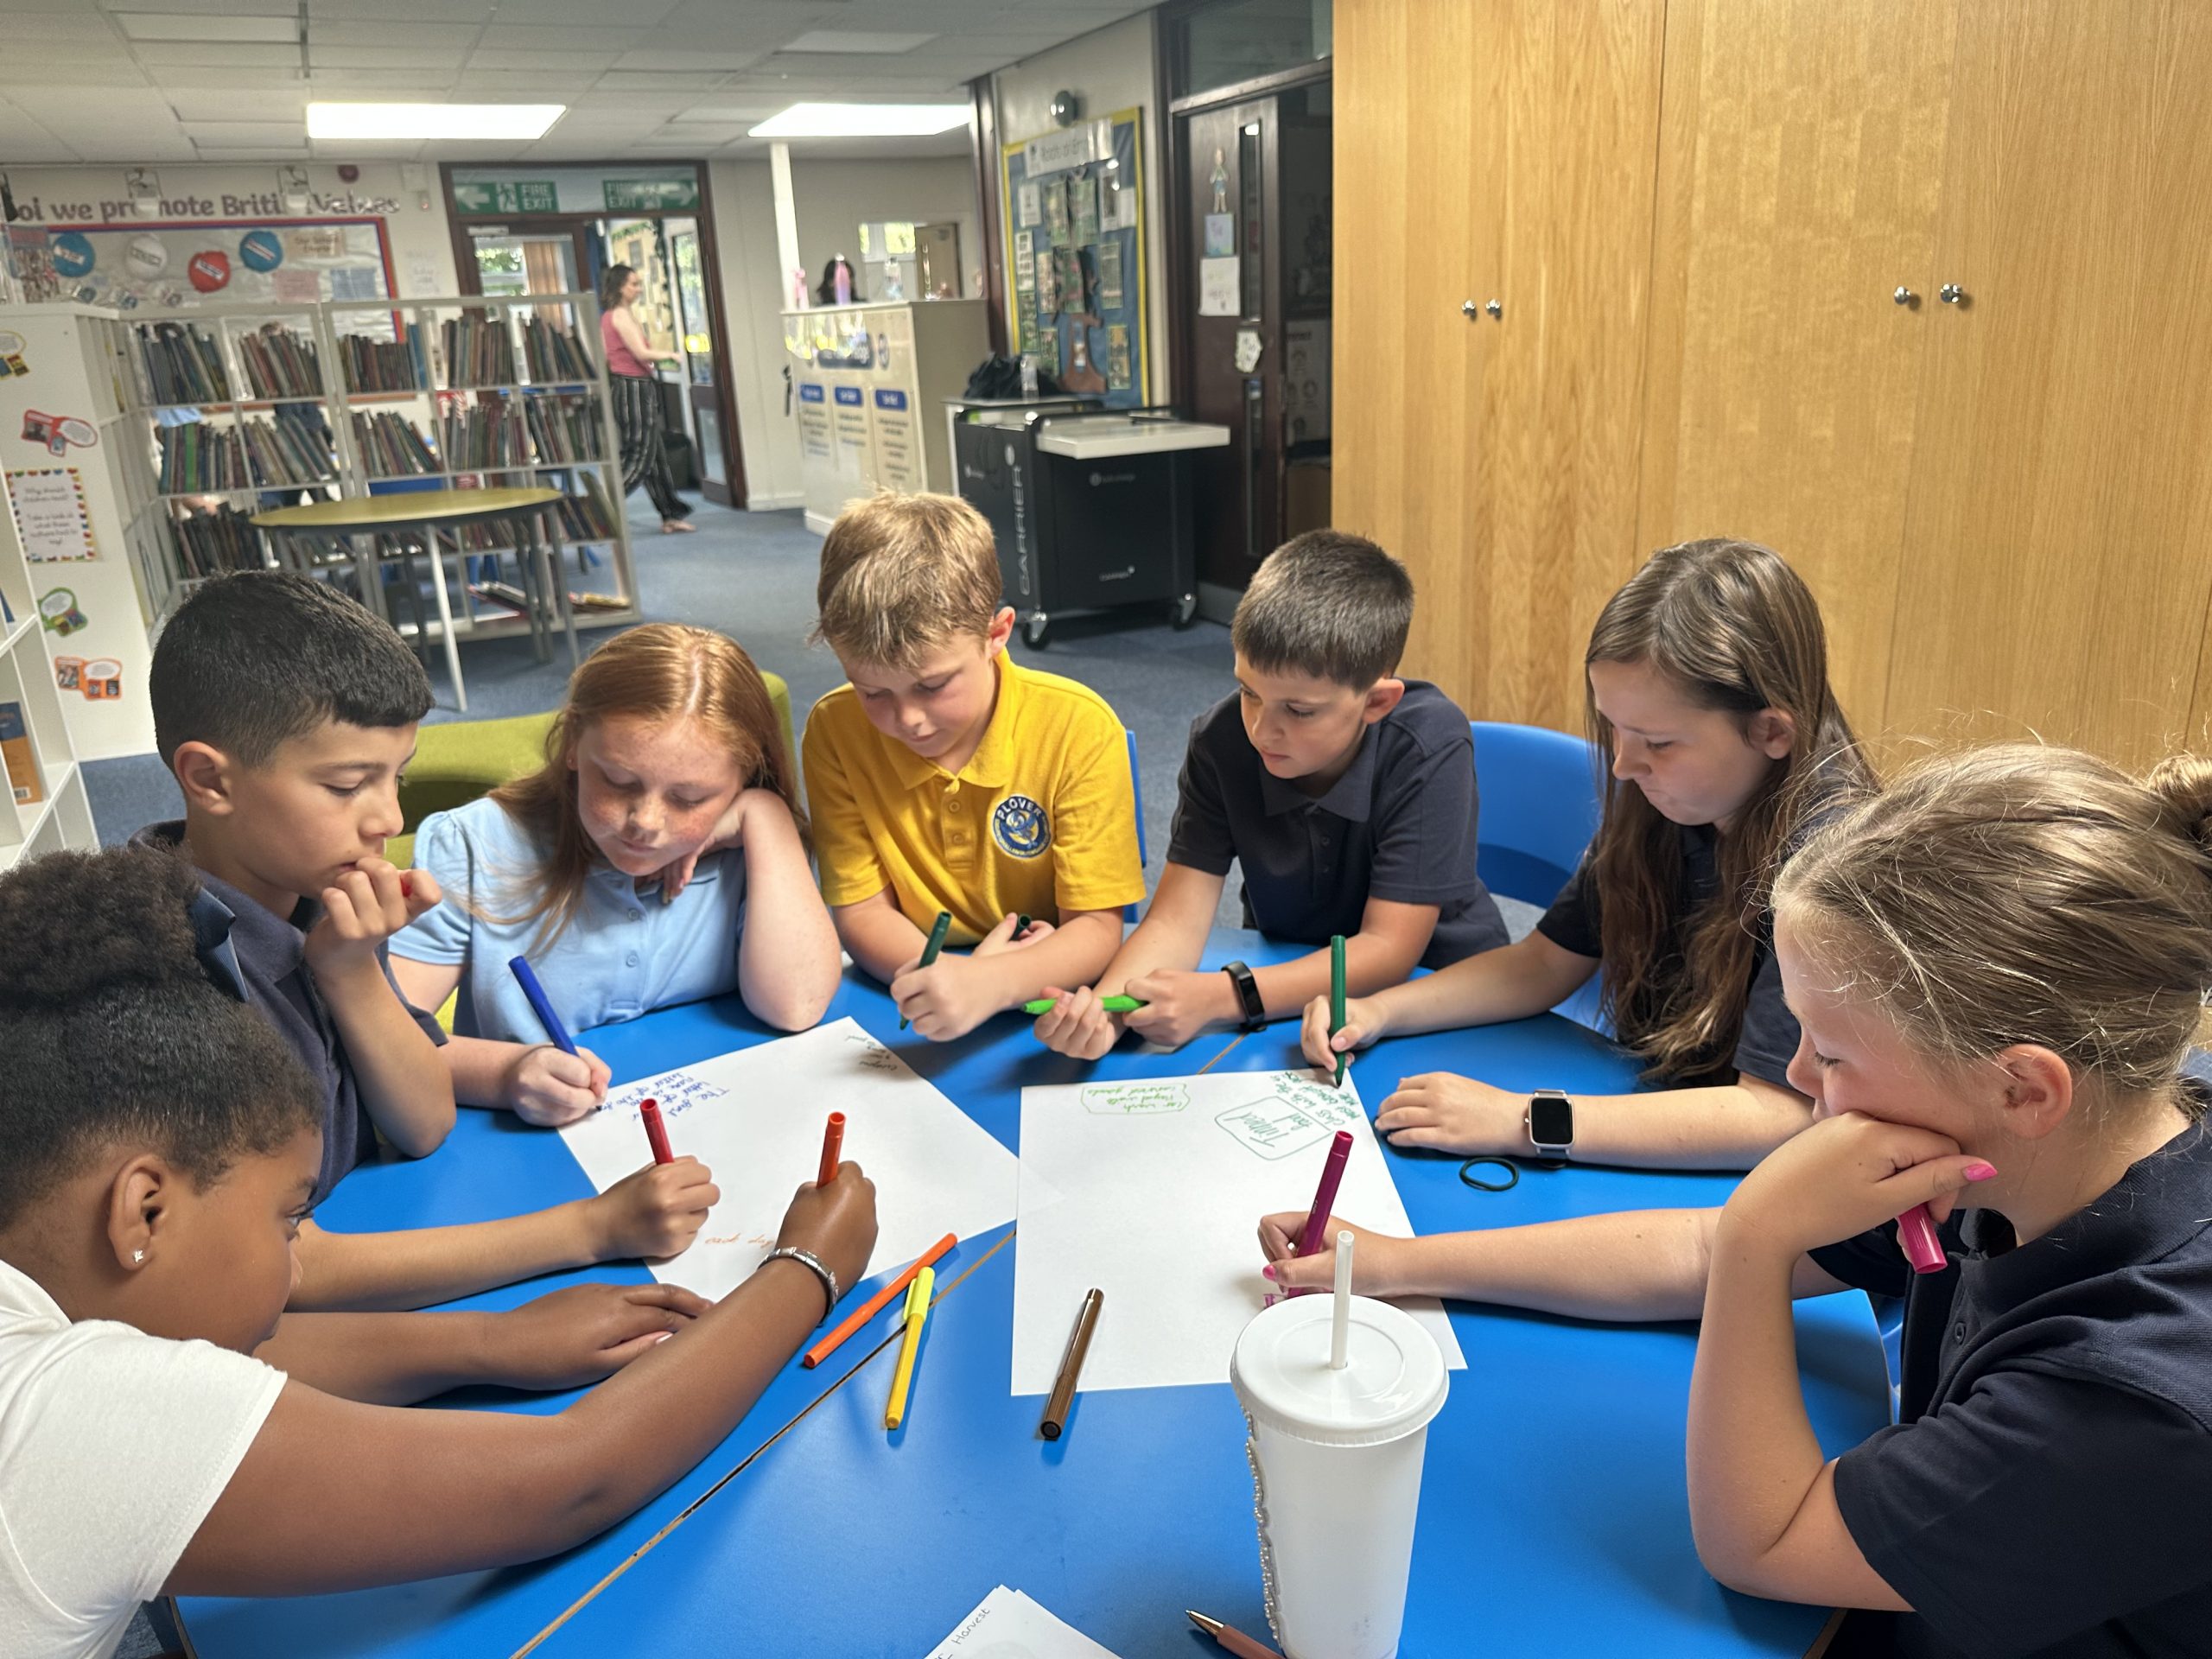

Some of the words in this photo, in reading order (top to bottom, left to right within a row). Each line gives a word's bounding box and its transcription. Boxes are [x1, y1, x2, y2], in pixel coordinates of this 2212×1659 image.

[50, 203, 92, 219] we
[524, 198, 553, 210] EXIT
[1012, 466, 1030, 595] CARRIER
[997, 797, 1042, 820] PLOVER
[950, 1607, 991, 1645] Harvest
